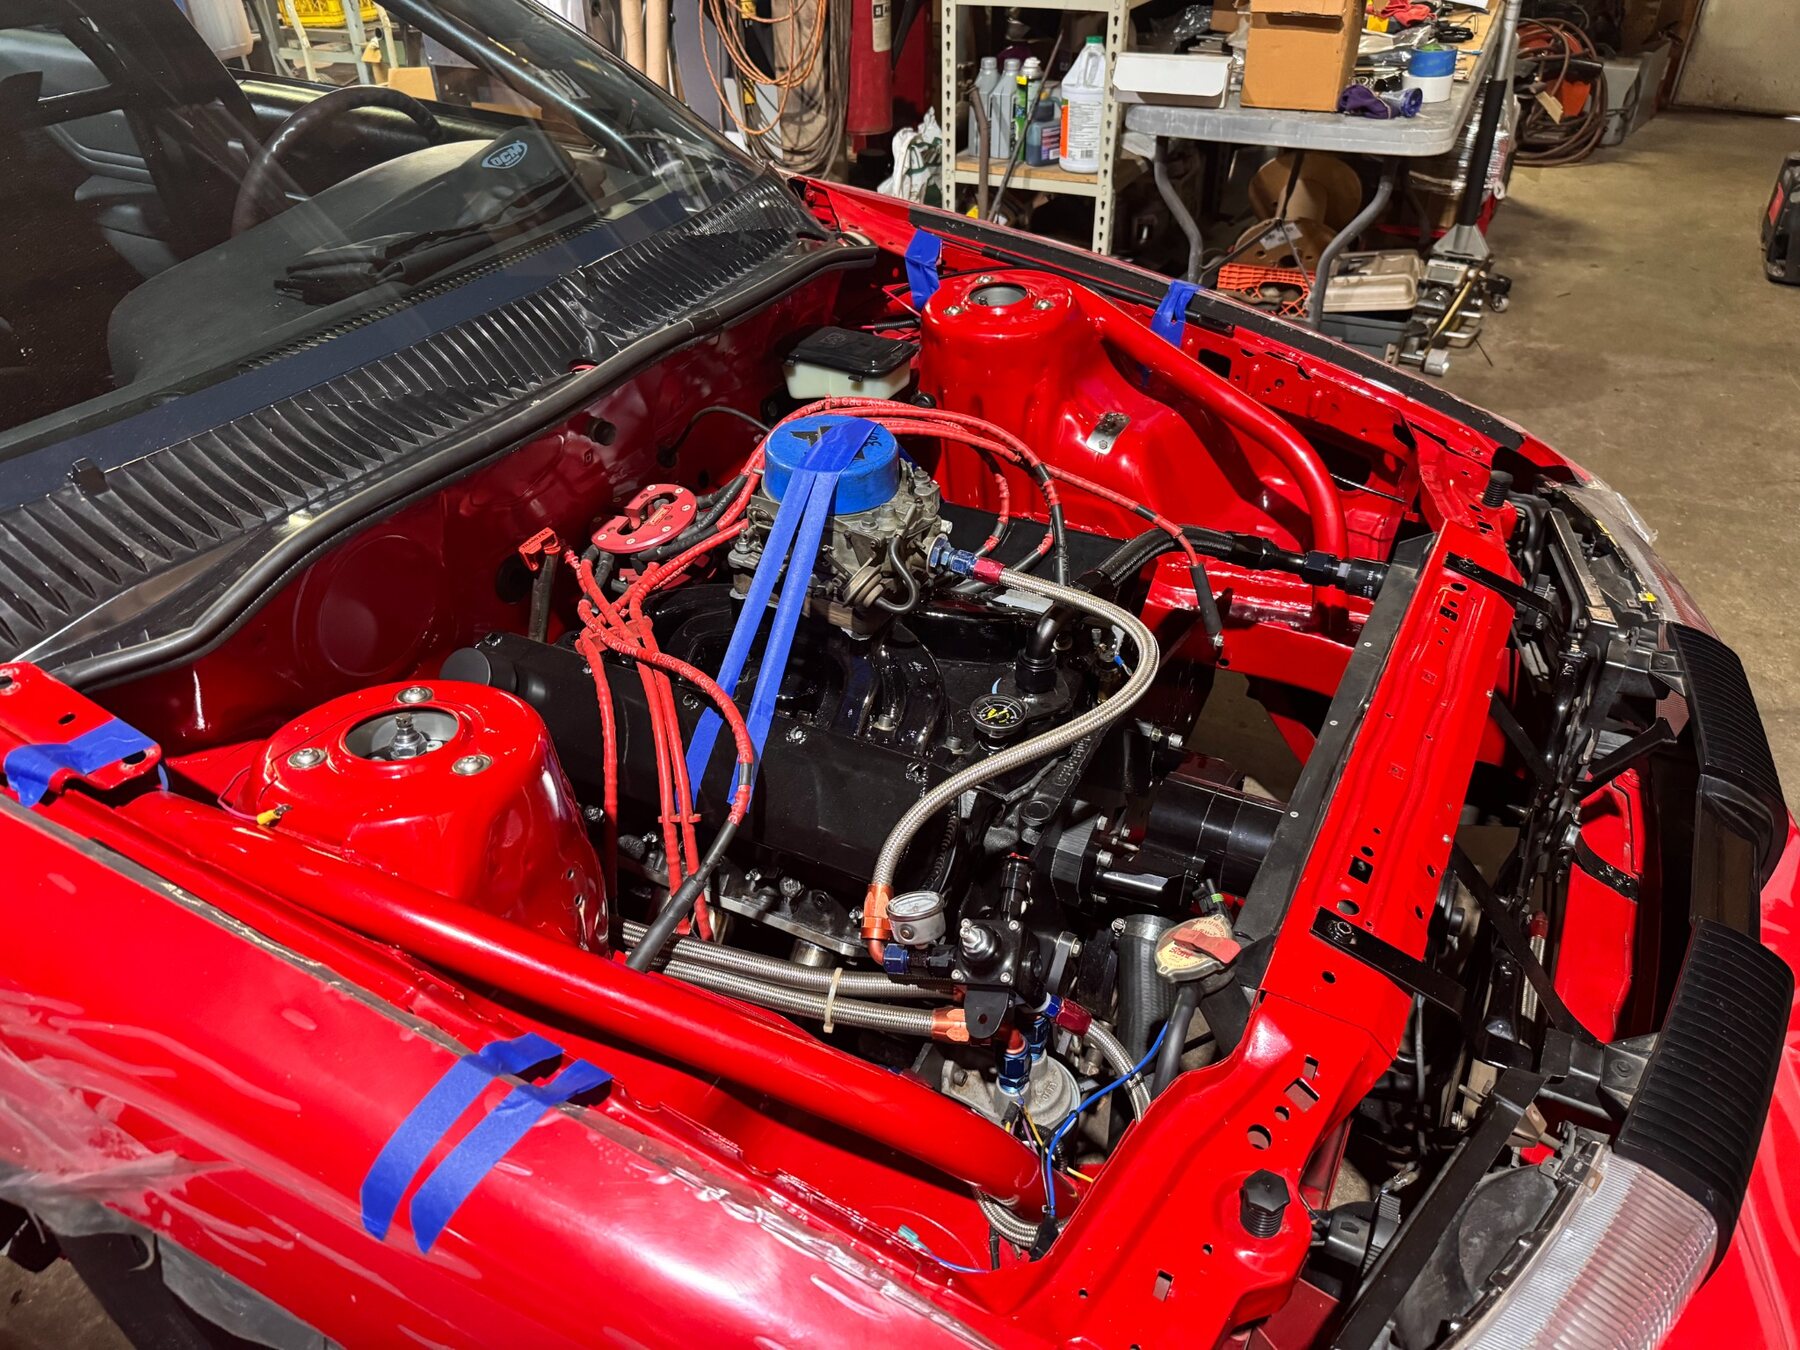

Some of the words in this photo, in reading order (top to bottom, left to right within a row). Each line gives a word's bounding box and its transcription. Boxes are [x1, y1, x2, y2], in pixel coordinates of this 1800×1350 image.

[697, 489, 733, 529] MALLORY
[652, 651, 678, 669] SHIELD
[678, 662, 694, 679] PRO
